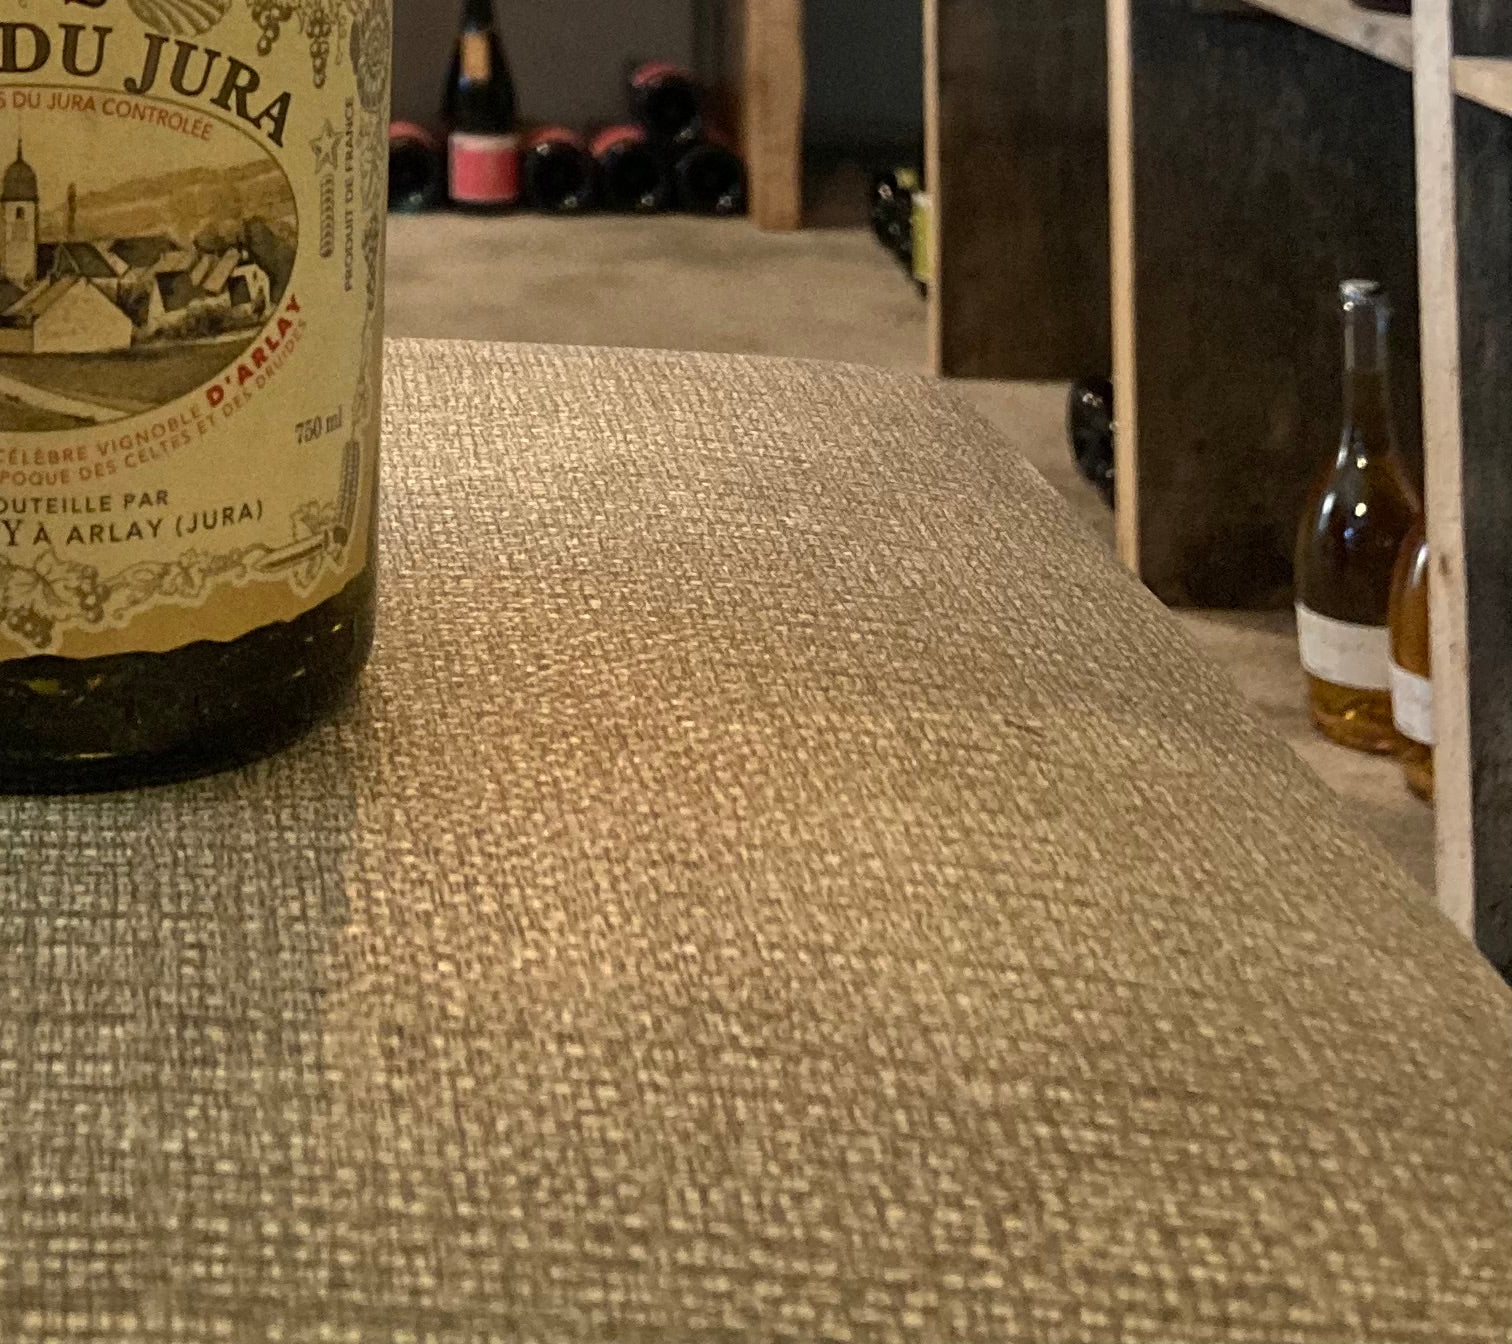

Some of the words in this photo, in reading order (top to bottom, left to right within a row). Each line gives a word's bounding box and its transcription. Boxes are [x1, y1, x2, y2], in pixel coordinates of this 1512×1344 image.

[13, 90, 41, 109] DU
[47, 92, 96, 112] JURA
[123, 32, 292, 148] JURA
[344, 96, 354, 172] FRANCE
[96, 404, 201, 457] VIGNOBLE
[205, 293, 302, 408] D'ARLAY
[79, 460, 117, 481] DES
[124, 428, 191, 469] CELTES
[196, 413, 217, 437] ET
[222, 388, 252, 419] DES
[294, 415, 322, 445] 750
[326, 404, 342, 434] ml
[66, 518, 163, 545] ARLAY
[175, 499, 263, 538] (JURA)
[123, 489, 169, 510] PAR
